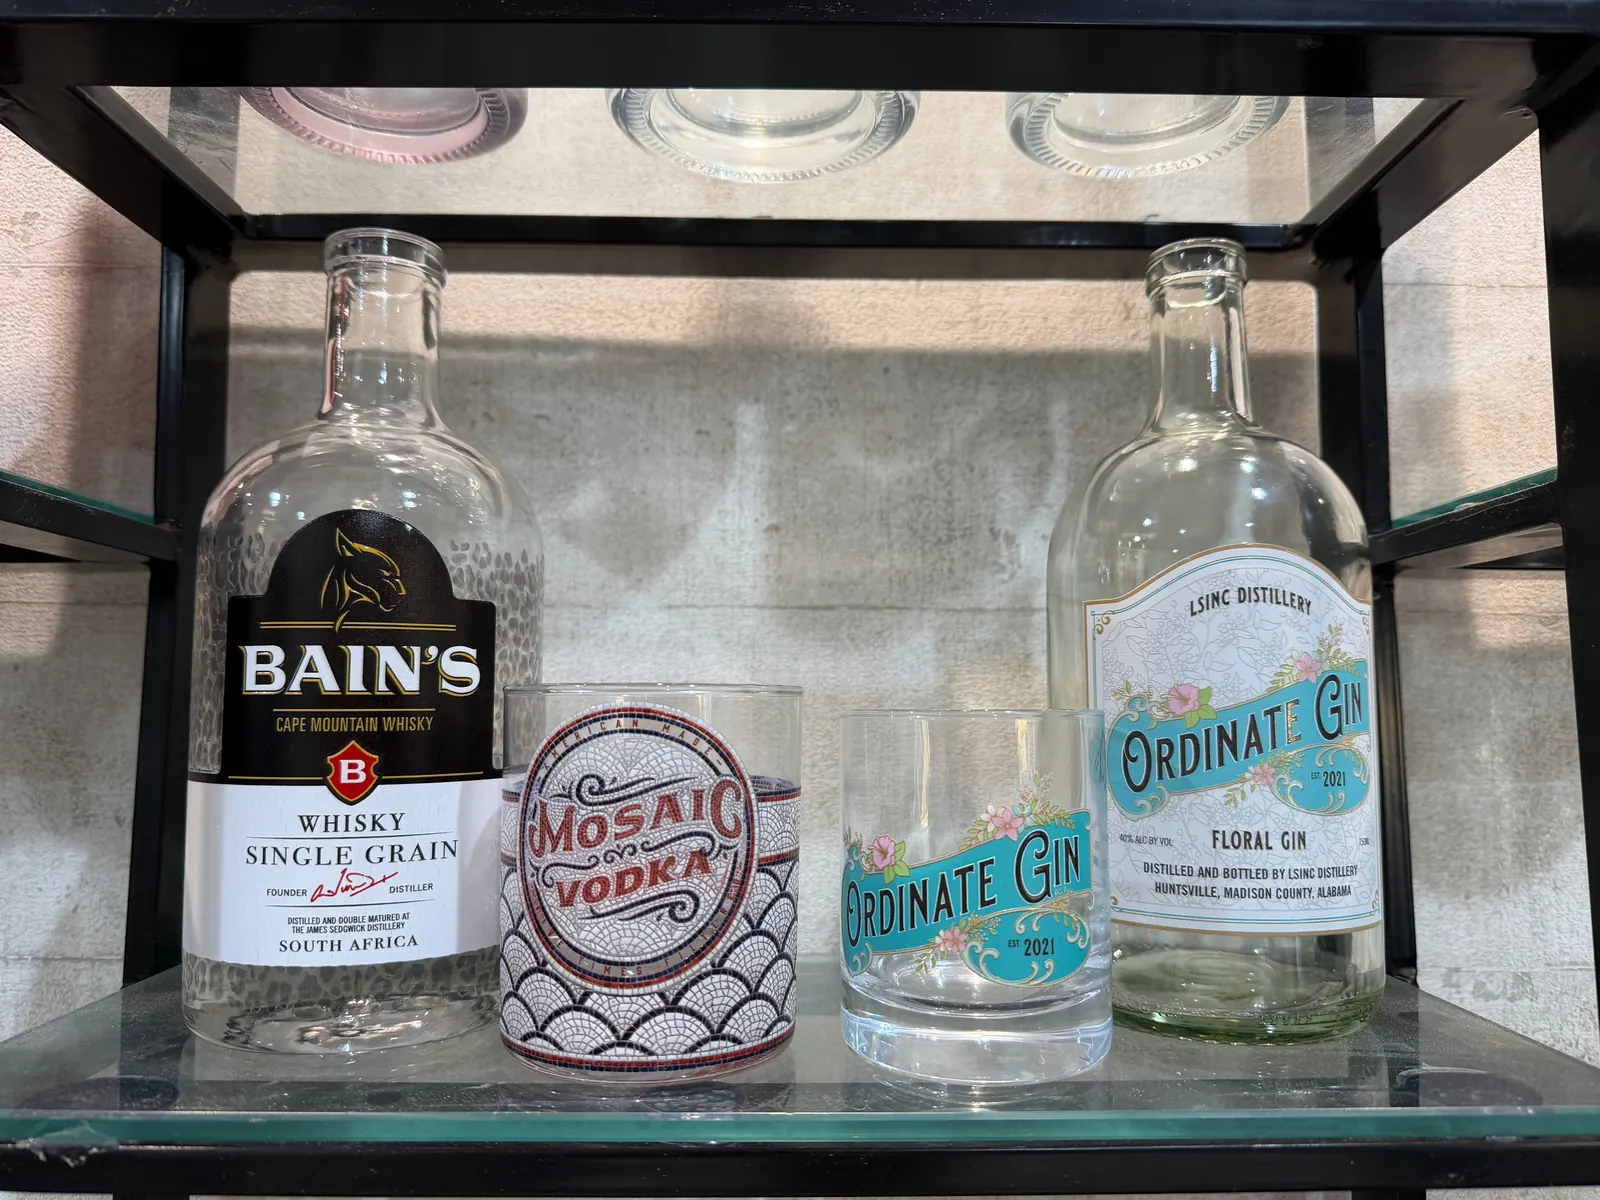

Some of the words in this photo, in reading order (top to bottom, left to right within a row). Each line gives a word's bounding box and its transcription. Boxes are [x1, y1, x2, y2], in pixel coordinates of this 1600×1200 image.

[1190, 588, 1230, 617] LSINC
[1237, 586, 1312, 616] DISTILLERY
[238, 644, 481, 697] BAIN'S
[276, 717, 306, 732] CAPE
[311, 717, 378, 732] MOUNTAIN
[382, 716, 434, 731] WHISKY
[1122, 698, 1301, 793] ORDINATE
[1314, 673, 1362, 741] GIN
[543, 719, 639, 771] AMERICAN
[662, 723, 713, 756] MADE
[339, 758, 367, 784] B
[1323, 770, 1346, 787] 2021
[297, 812, 406, 833] WHISKY
[528, 778, 743, 859] MOSAIC
[1149, 836, 1158, 845] BY
[1212, 829, 1273, 850] FLORAL
[1281, 830, 1307, 850] GIN
[246, 845, 353, 866] SINGLE
[365, 839, 459, 865] GRAIN
[555, 849, 712, 908] VODKA
[1143, 861, 1194, 877] DISTILLED
[1197, 866, 1219, 878] AND
[1223, 867, 1269, 880] BOTTLED
[1272, 868, 1286, 880] BY
[1288, 867, 1315, 880] LSINC
[1318, 864, 1358, 879] DISTILLERY
[266, 888, 308, 897] FOUNDER
[389, 882, 434, 894] DISTILLER
[847, 857, 998, 948] ORDINATE
[1014, 830, 1080, 904] GIN
[1155, 881, 1221, 899] HUNTSVILLE,
[1224, 886, 1272, 899] MADISON
[1275, 886, 1315, 899] COUNTY,
[1317, 884, 1352, 898] ALABAMA
[287, 916, 321, 925] DISTILLED
[322, 916, 337, 925] AND
[338, 915, 367, 924] DOUBLE
[368, 913, 401, 923] MATURED
[401, 912, 410, 920] AT
[292, 925, 305, 934] THE
[306, 925, 328, 934] JAMES
[329, 924, 366, 933] SEDGWICK
[367, 922, 406, 932] DISTILLERY
[279, 939, 342, 952] SOUTH
[349, 934, 419, 951] AFRICA
[1024, 937, 1055, 957] 2021
[578, 956, 645, 977] TIMES
